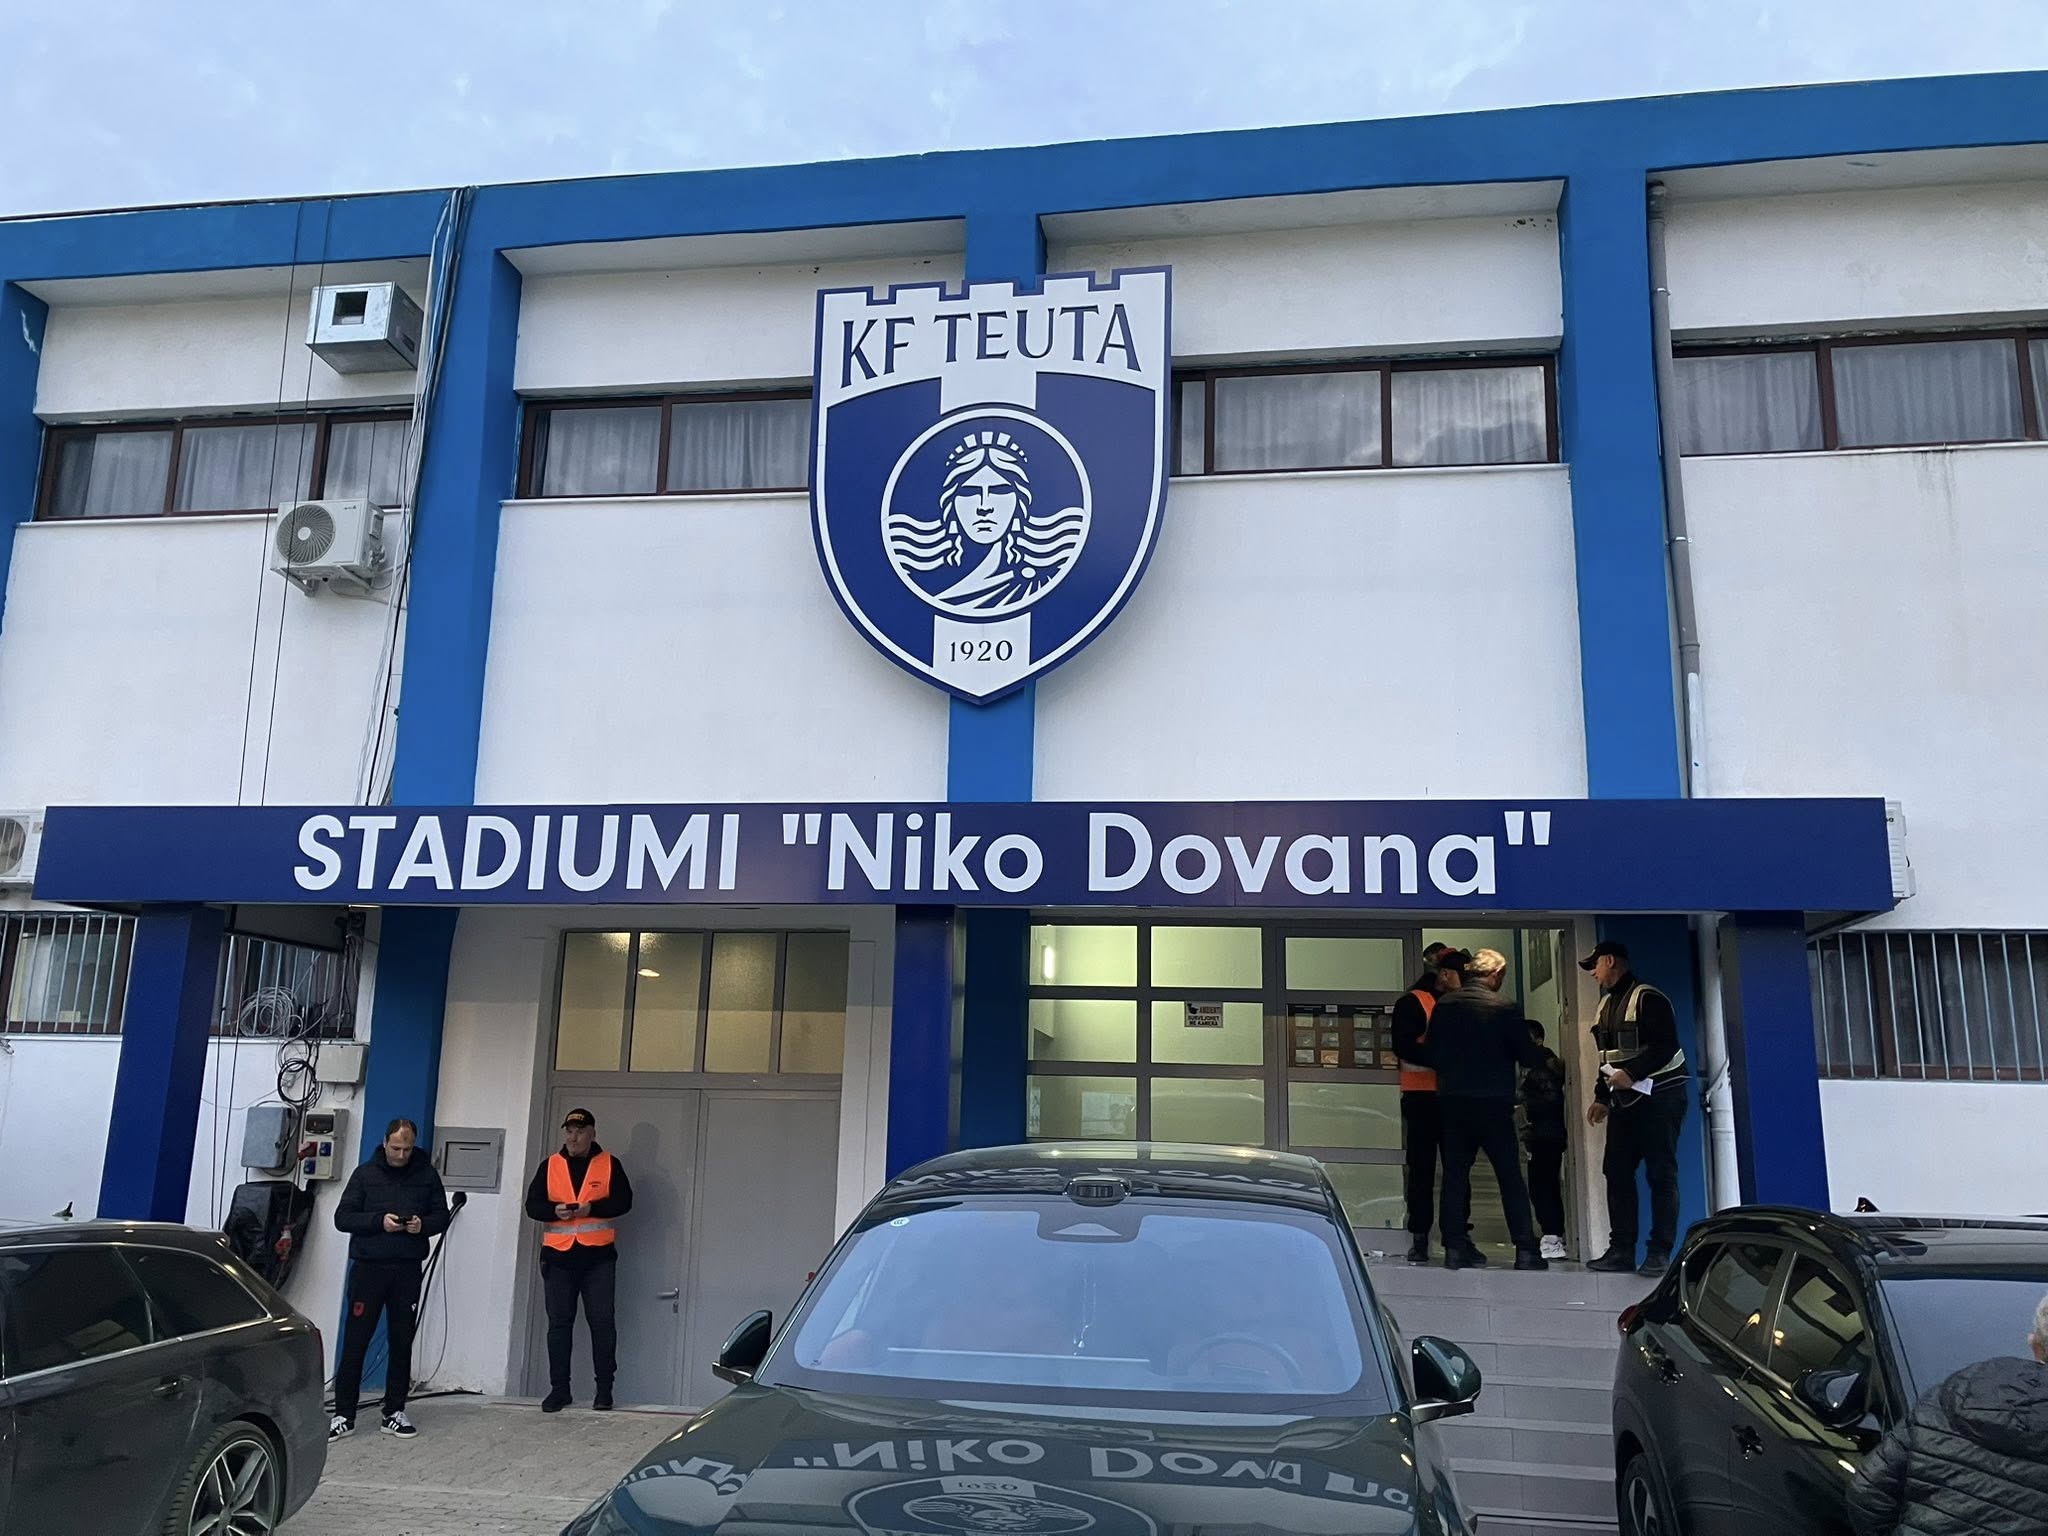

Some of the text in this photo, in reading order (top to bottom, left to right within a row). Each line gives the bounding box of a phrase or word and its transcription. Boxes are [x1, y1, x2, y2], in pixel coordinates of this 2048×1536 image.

[840, 303, 1143, 389] KF TEUTA
[949, 639, 1014, 663] 1920
[293, 810, 1552, 897] STADIUMI "Niko Dovana"
